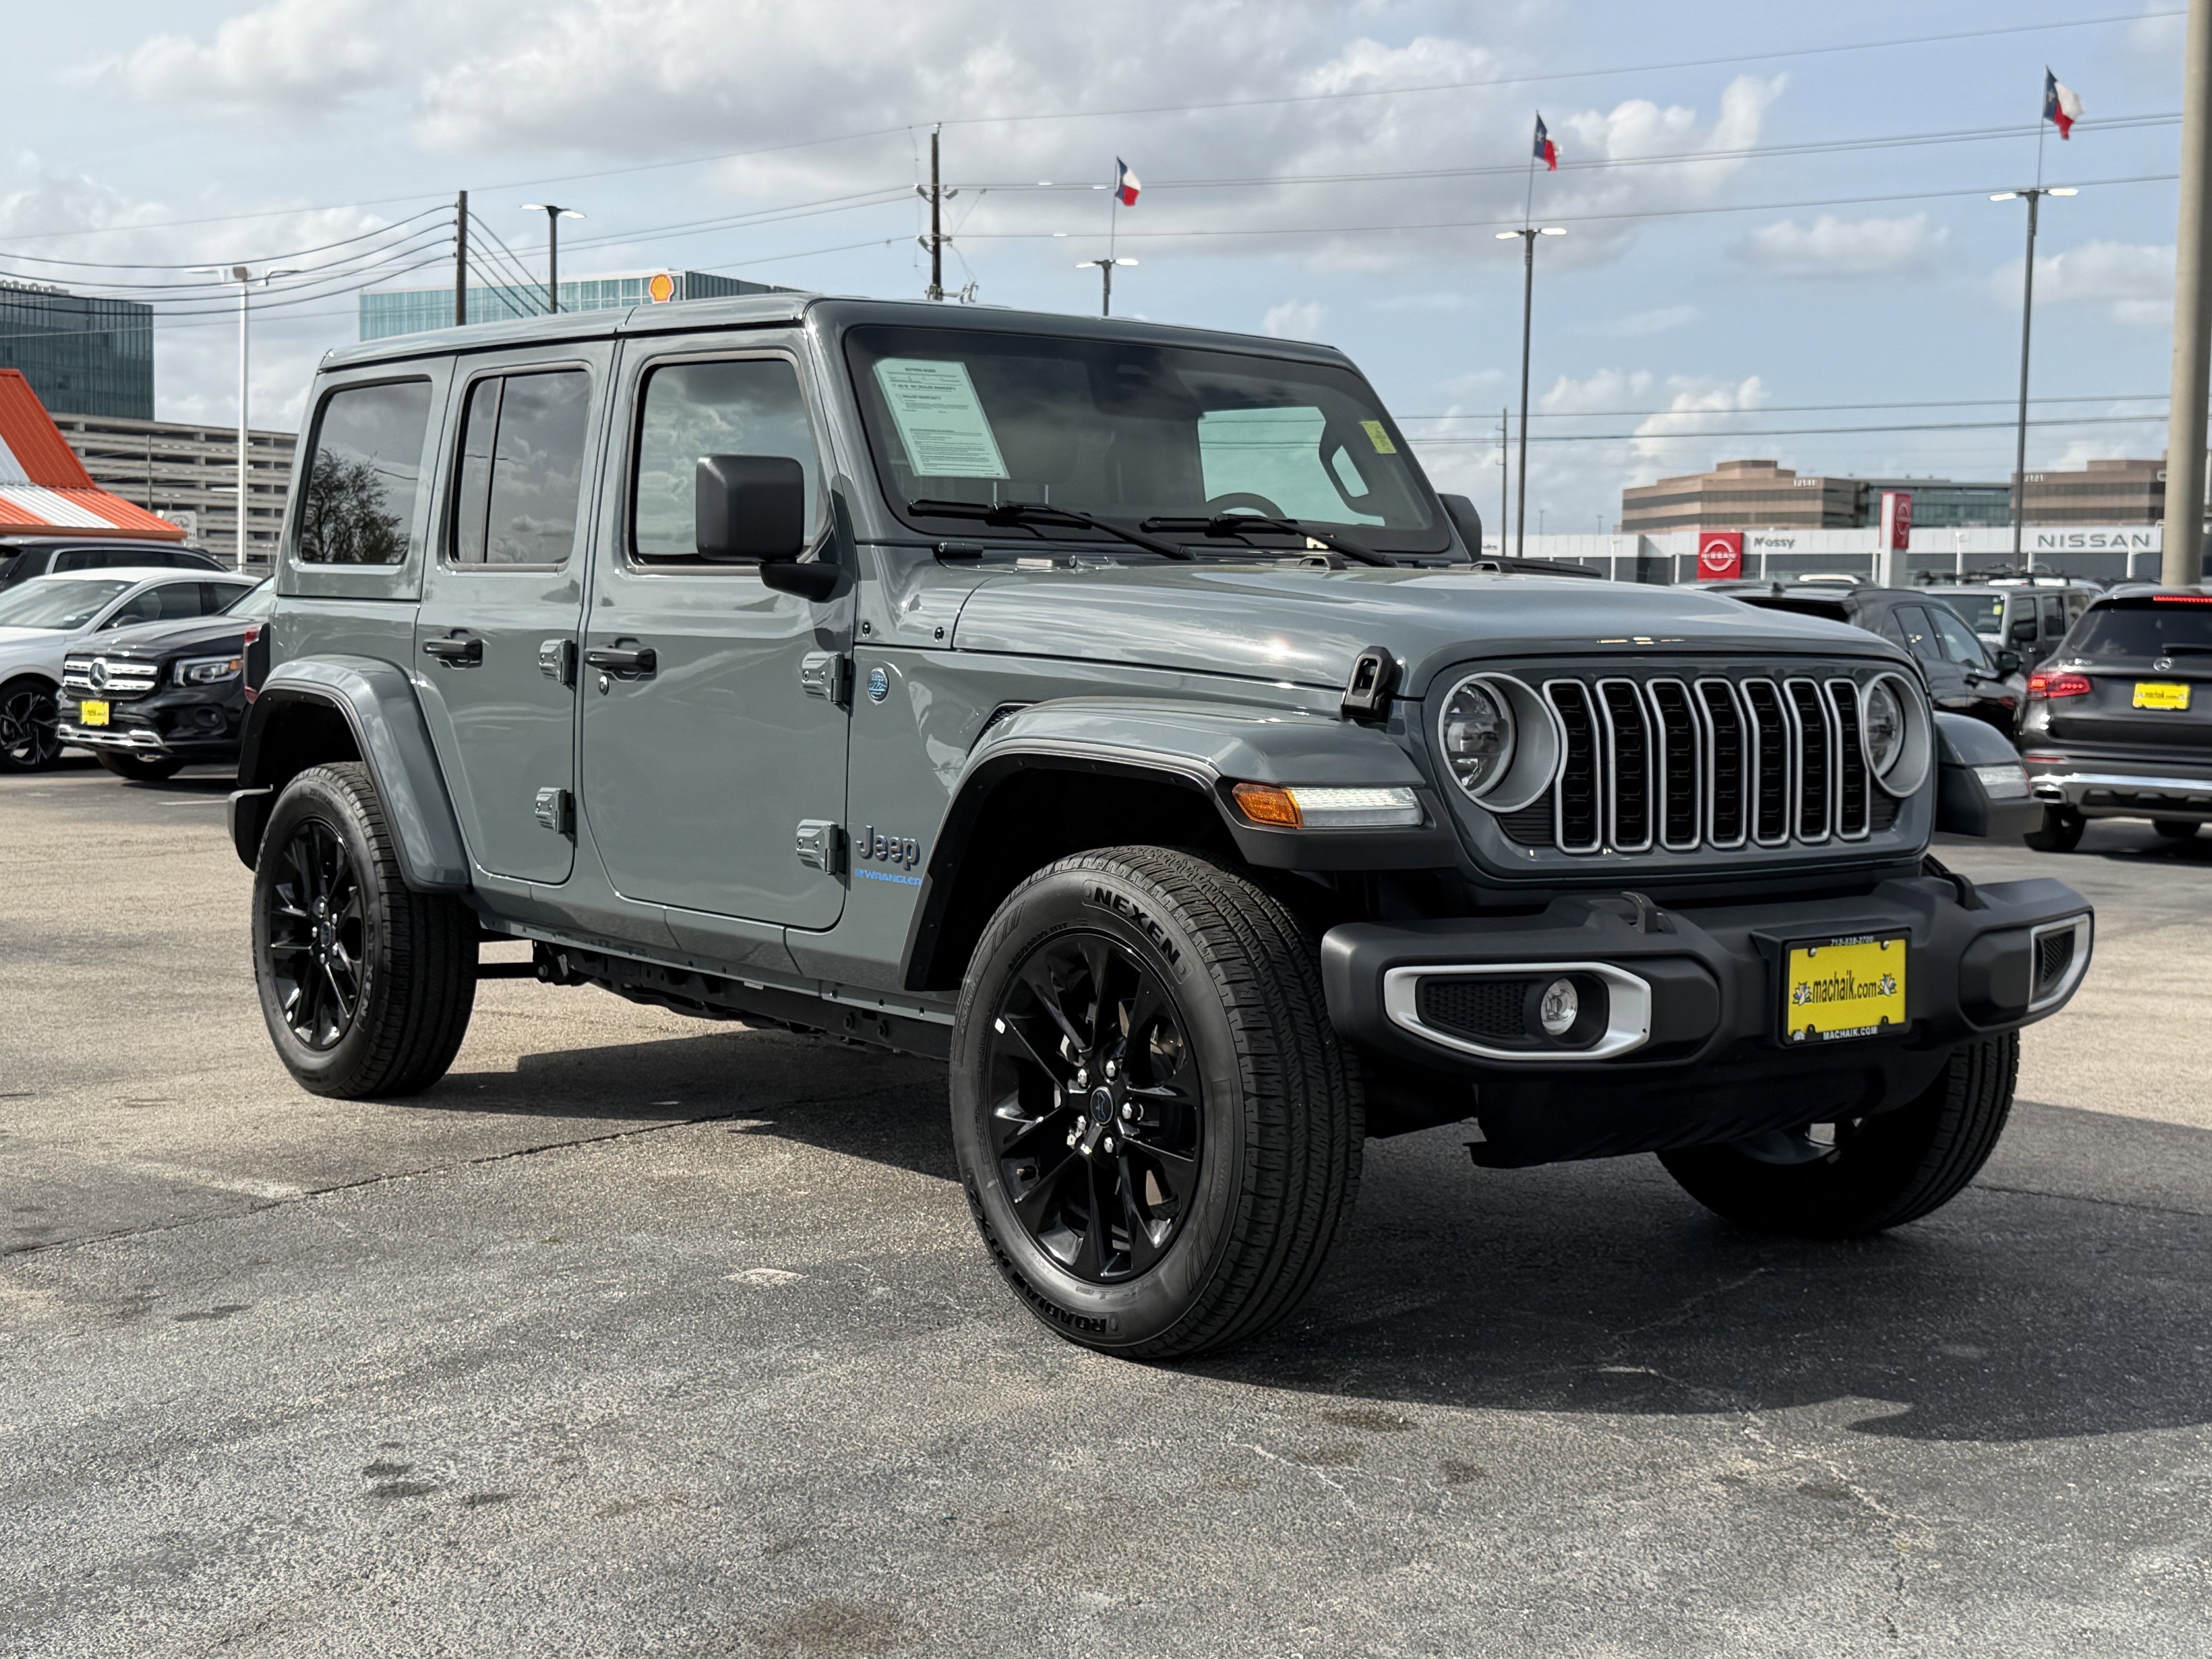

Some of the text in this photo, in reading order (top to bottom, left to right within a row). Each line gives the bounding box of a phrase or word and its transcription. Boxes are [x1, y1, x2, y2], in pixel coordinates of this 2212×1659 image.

[1753, 537, 1796, 550] Mossy
[2038, 533, 2150, 548] NISSAN
[856, 825, 920, 871] Jeep
[1094, 887, 1181, 967] NEXEN
[1812, 969, 1877, 1004] machaik.com
[1823, 1026, 1878, 1041] MACHAIK.COM
[1012, 1270, 1107, 1333] ROADIAN
